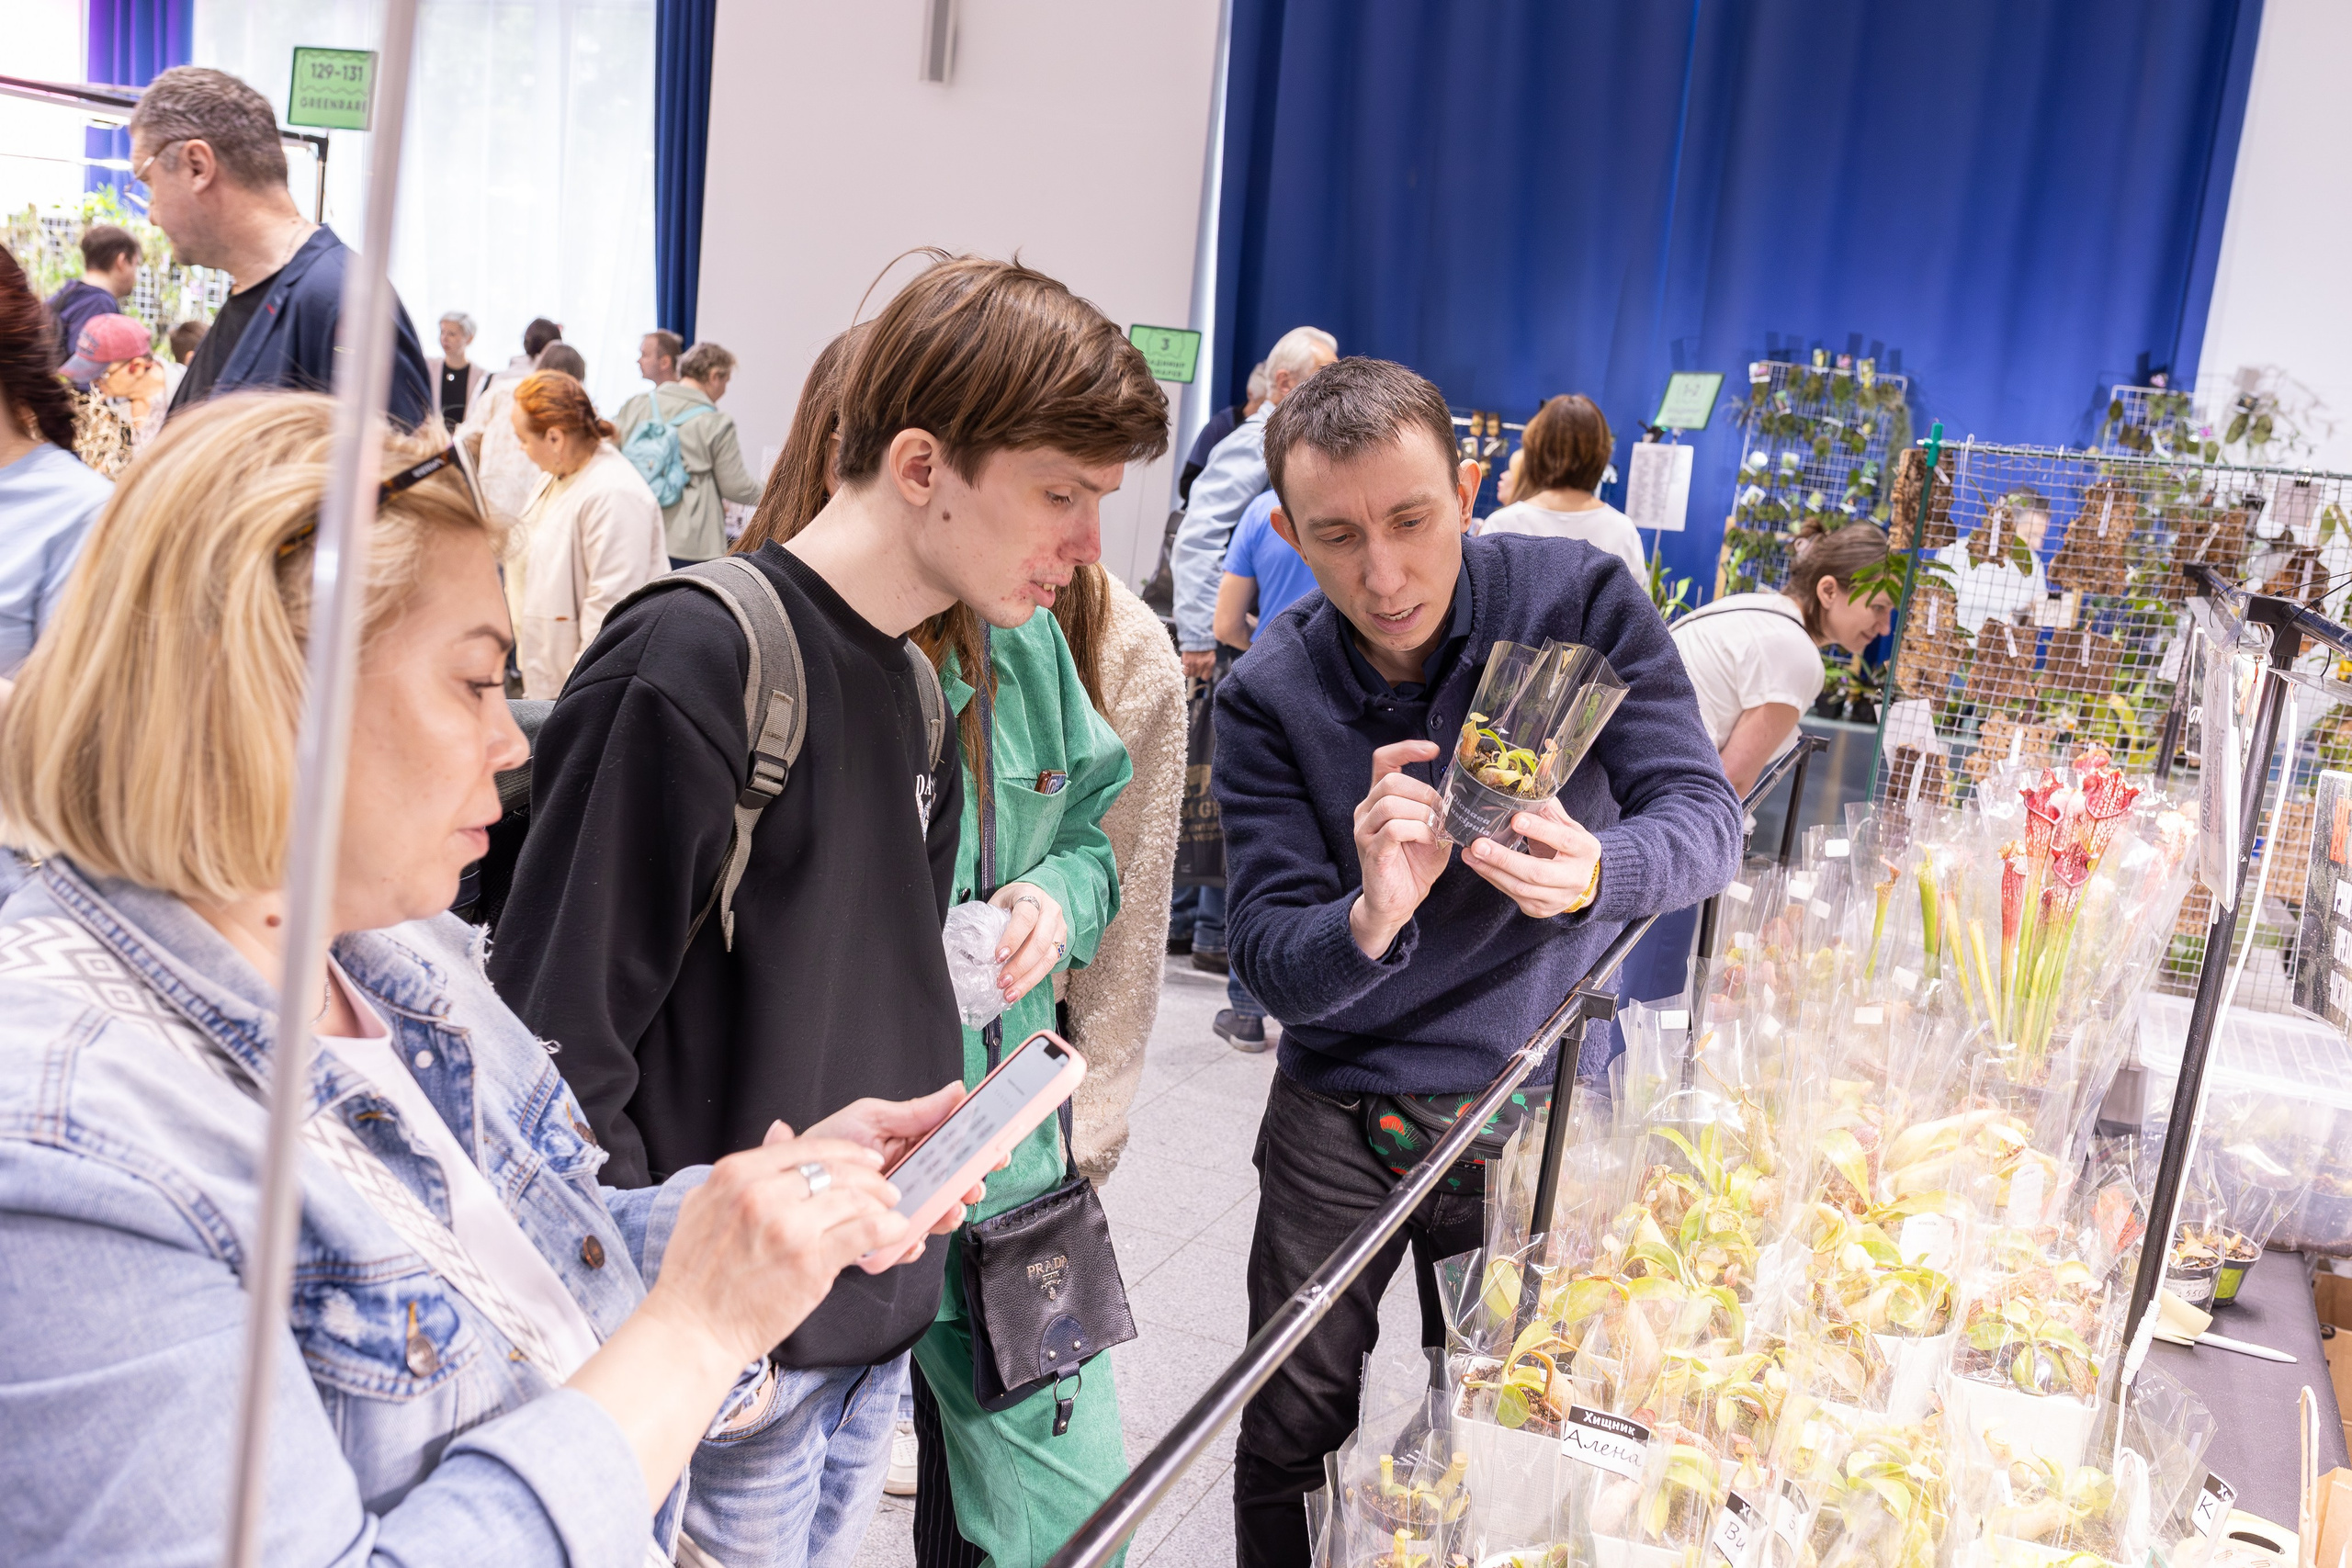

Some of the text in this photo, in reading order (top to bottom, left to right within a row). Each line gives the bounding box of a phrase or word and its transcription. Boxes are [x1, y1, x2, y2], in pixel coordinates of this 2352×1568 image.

[311, 62, 363, 82] 129-131
[1161, 337, 1170, 350] 3
[1451, 807, 1490, 836] uscipula
[1026, 1255, 1069, 1278] PRADA
[1583, 1411, 1636, 1437] Хищник
[1564, 1429, 1643, 1468] Алена
